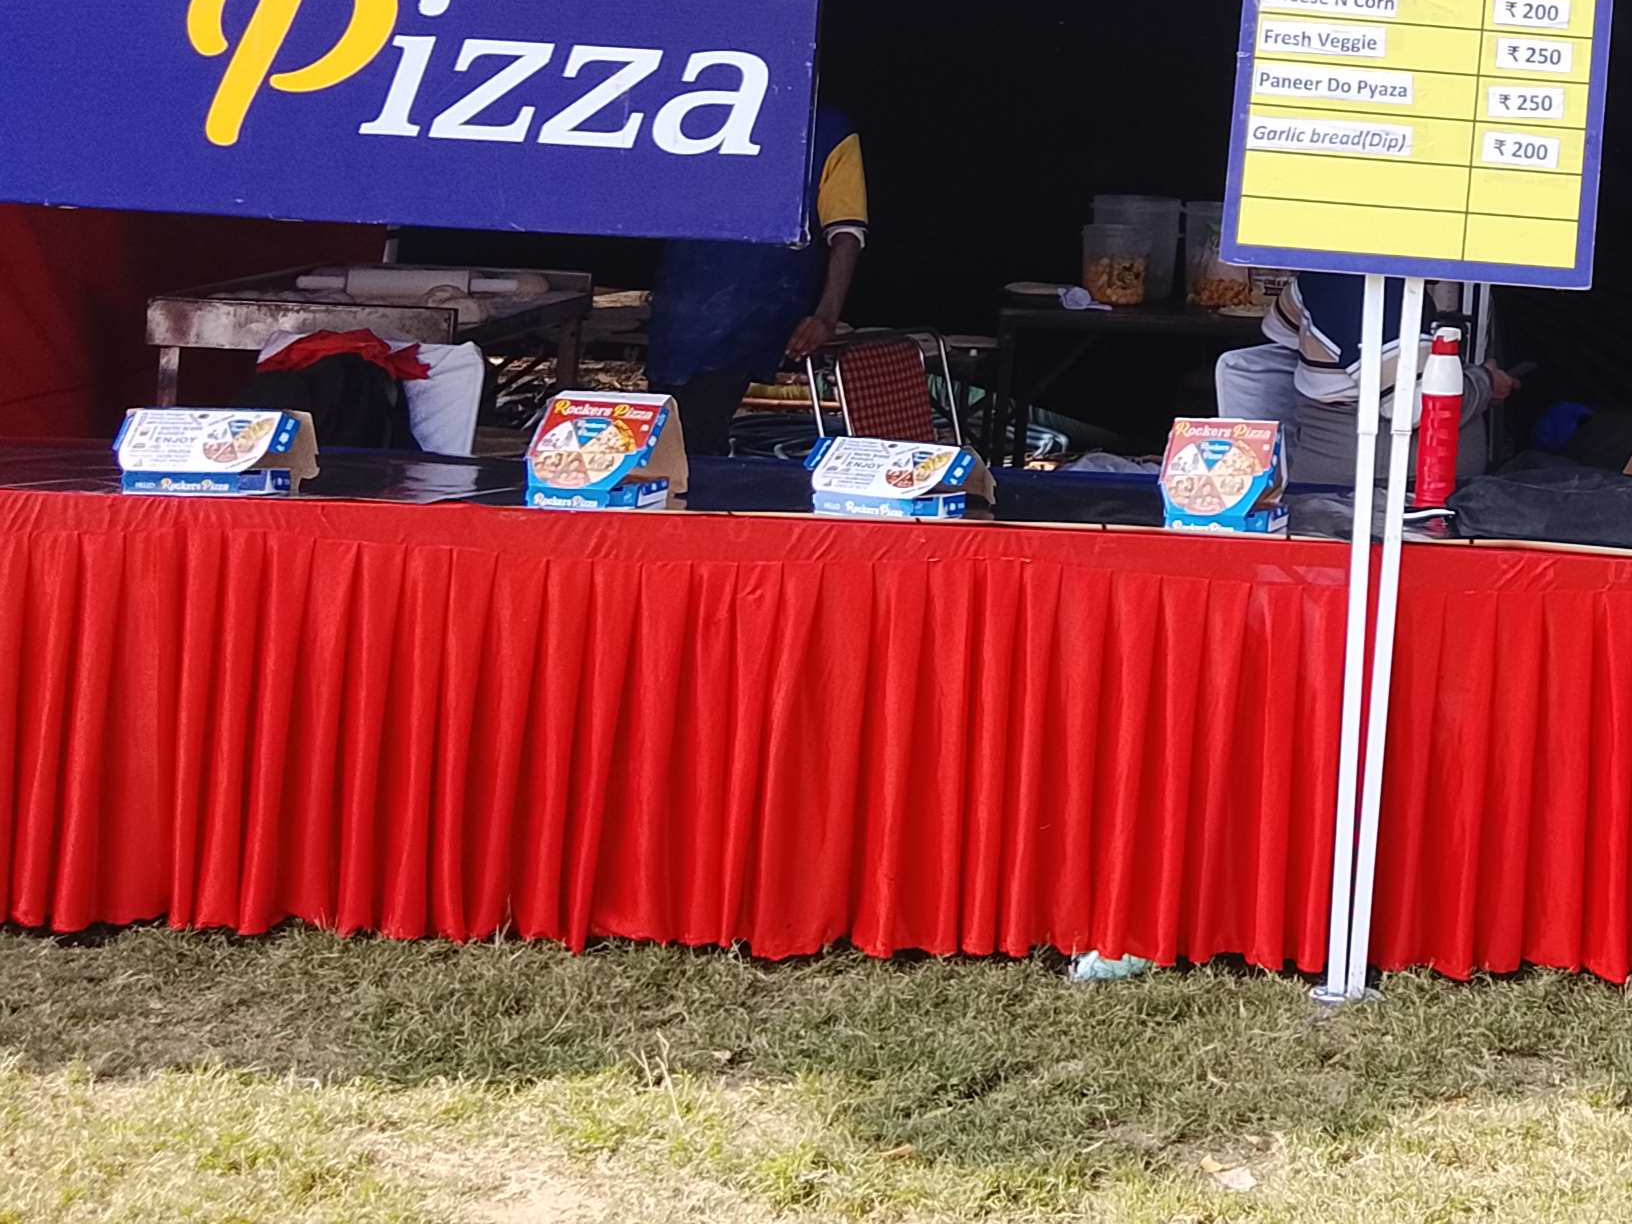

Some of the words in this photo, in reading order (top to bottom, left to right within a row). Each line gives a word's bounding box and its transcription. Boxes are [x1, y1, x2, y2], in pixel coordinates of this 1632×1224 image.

[1520, 1, 1560, 22] 200
[1263, 28, 1312, 49] Fresh
[1317, 32, 1378, 53] Veggie
[1524, 46, 1563, 66] 250
[1259, 72, 1323, 94] Paneer
[1327, 76, 1353, 95] Do
[1356, 80, 1409, 101] Pyaza
[1515, 94, 1554, 113] 250
[1252, 124, 1305, 145] Garlic
[1309, 127, 1408, 154] bread(Dip)
[1510, 141, 1549, 162] 200
[555, 400, 613, 417] Rockers
[613, 404, 654, 420] Pizza
[1174, 421, 1232, 437] Rockers
[1232, 424, 1272, 440] Pizza
